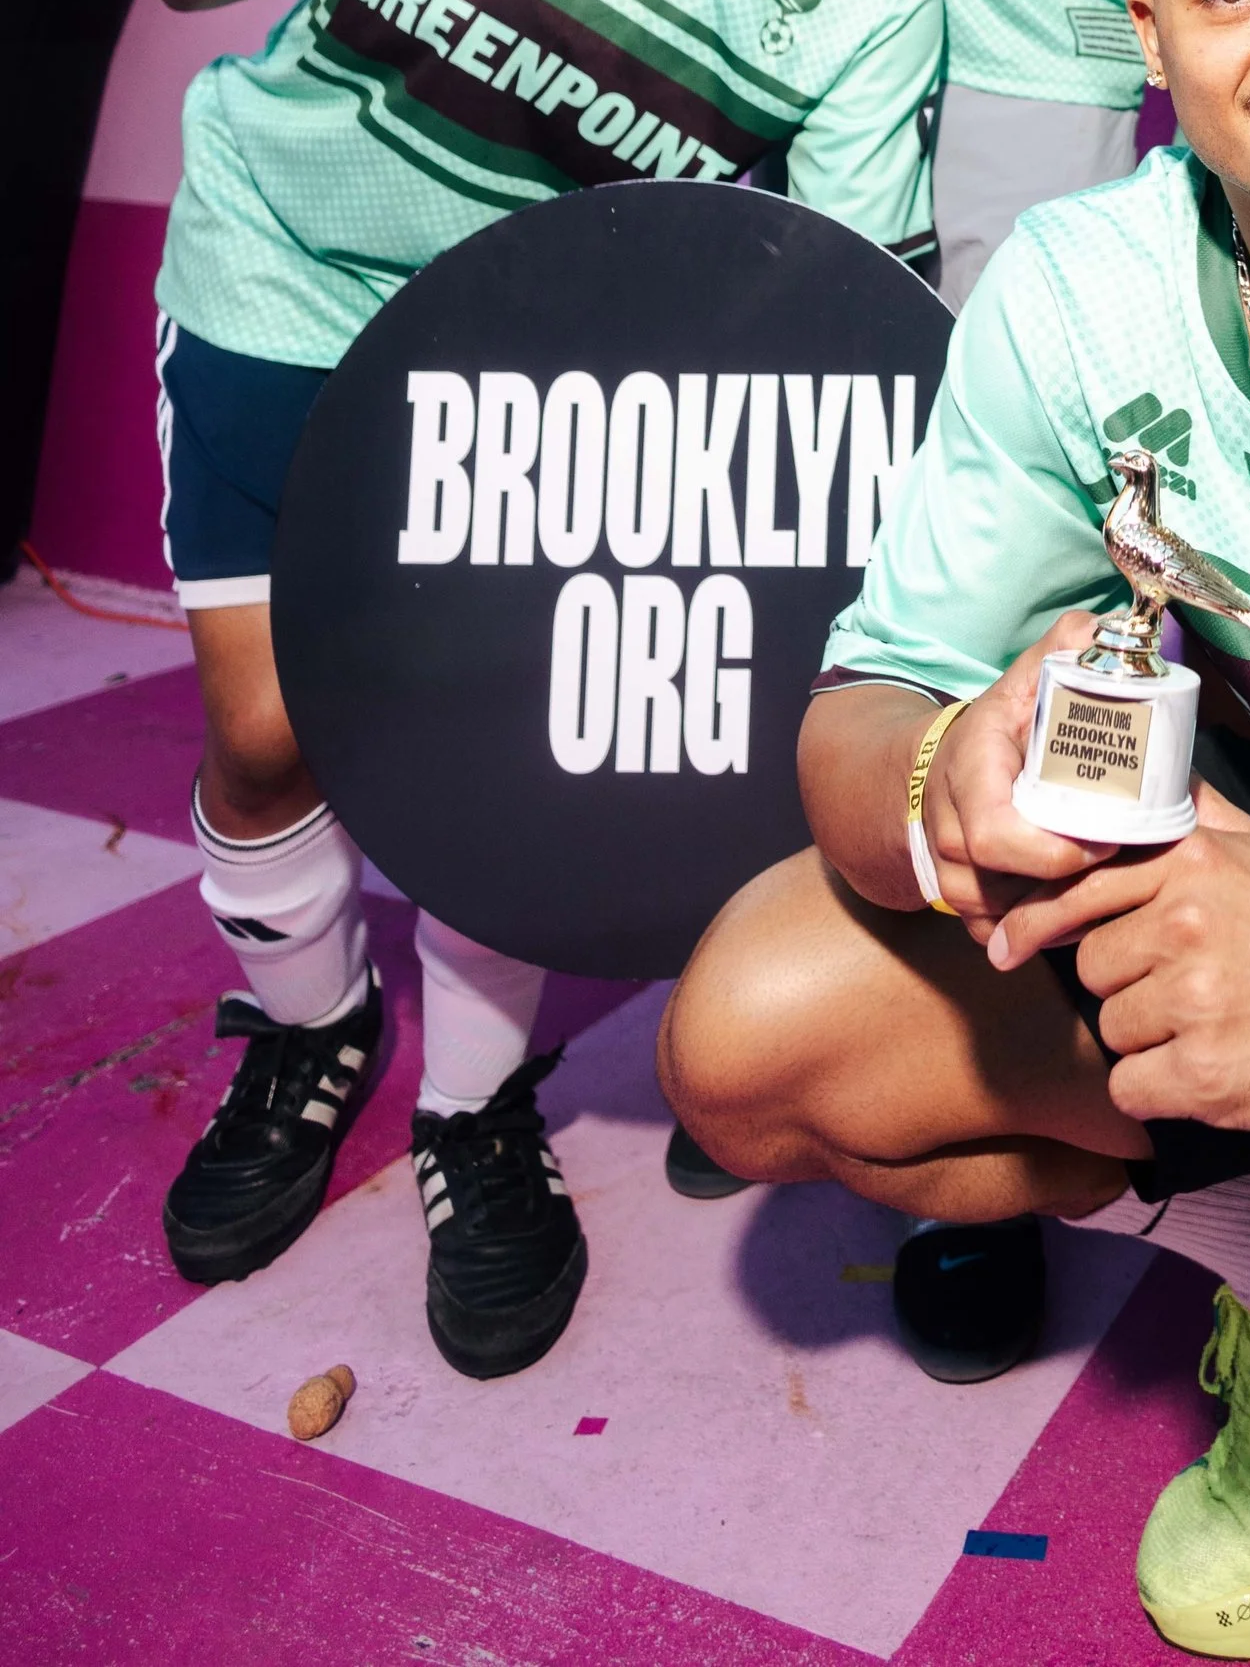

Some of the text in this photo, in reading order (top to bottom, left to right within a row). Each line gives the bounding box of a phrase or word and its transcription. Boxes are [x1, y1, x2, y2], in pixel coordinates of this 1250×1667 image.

[398, 370, 916, 568] BROOKLYN
[549, 572, 754, 775] ORG
[1067, 700, 1132, 730] BROOKLYN ORG
[1056, 722, 1137, 752] BROOKLYN
[1050, 739, 1139, 771] CHAMPIONS
[1076, 762, 1107, 782] CUP
